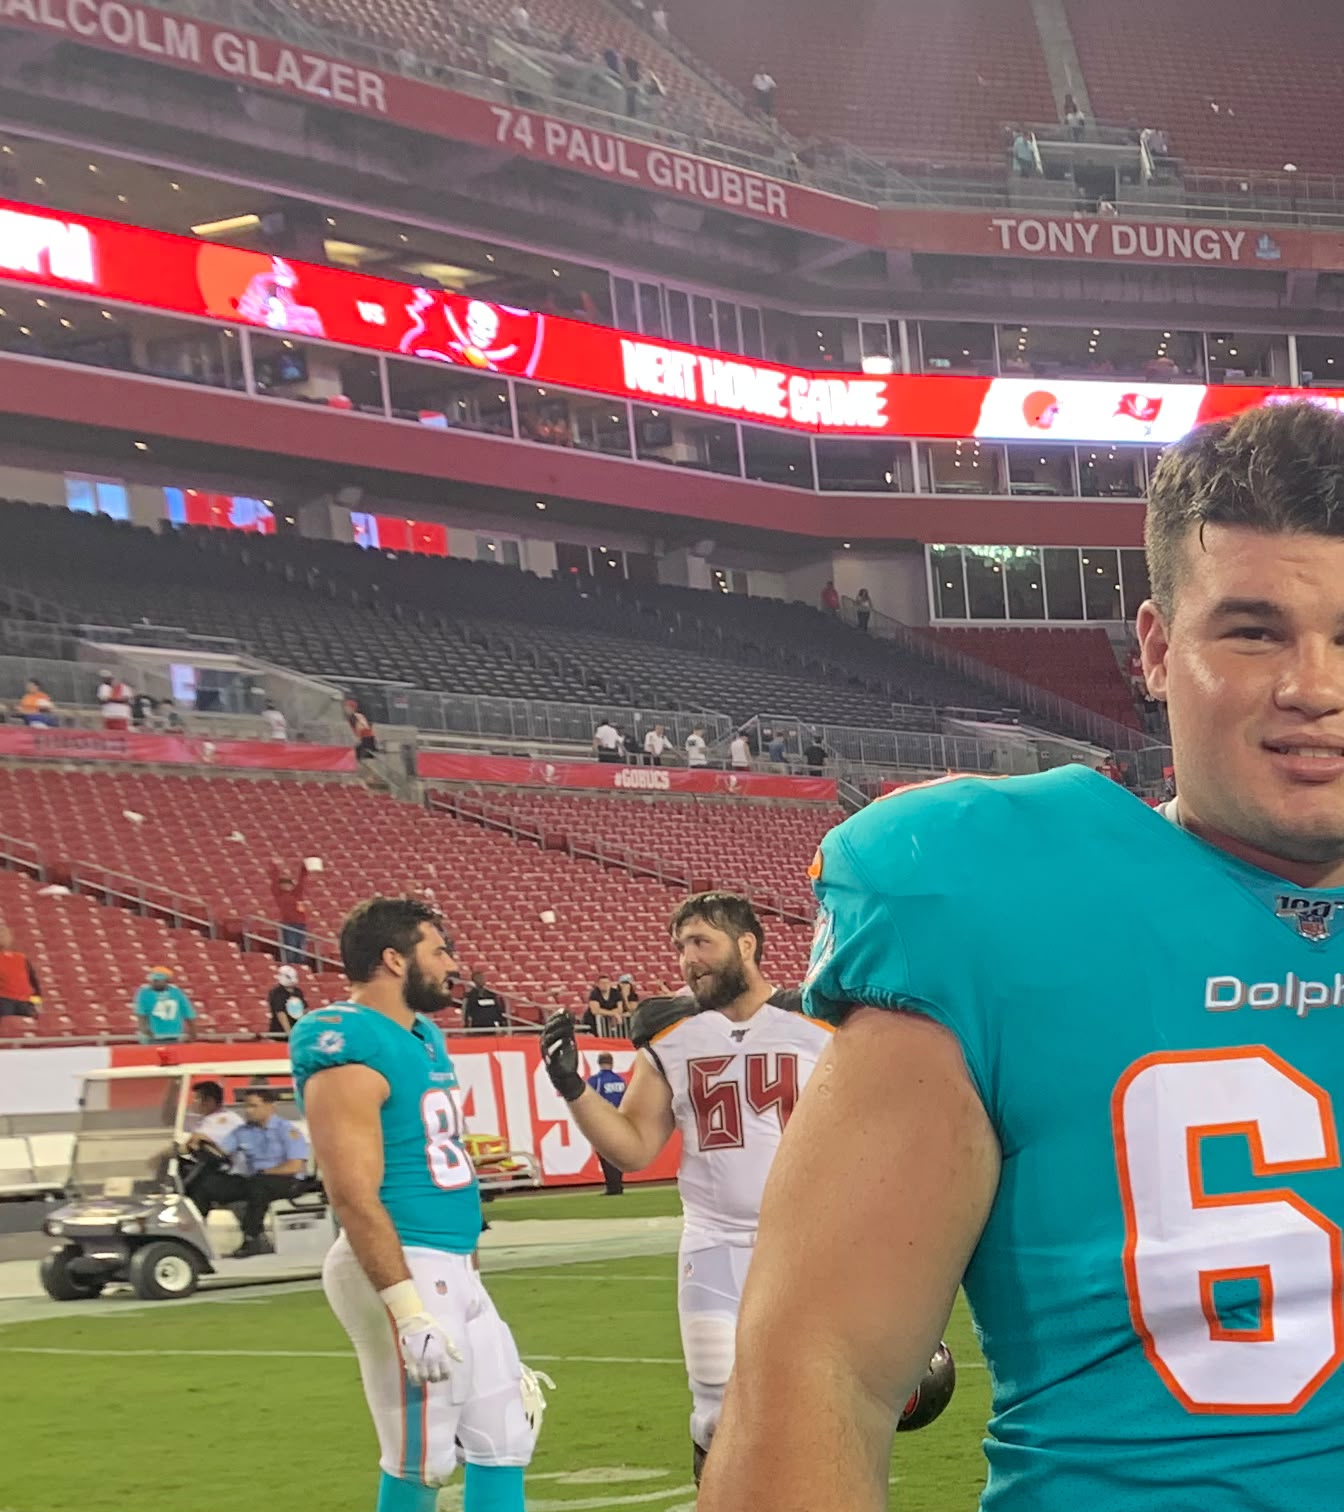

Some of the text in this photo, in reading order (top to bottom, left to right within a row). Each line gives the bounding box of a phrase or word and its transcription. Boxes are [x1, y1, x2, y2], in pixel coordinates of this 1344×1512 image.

[0, 0, 388, 113] ALCOLM GLAZER
[490, 106, 788, 218] 74 PAUL GRUBER
[994, 217, 1246, 262] TONY DUNGY
[620, 338, 888, 428] NEXT HOME GAME
[614, 768, 670, 789] #GOBUCS
[421, 1087, 473, 1190] 8
[687, 1052, 799, 1152] 64
